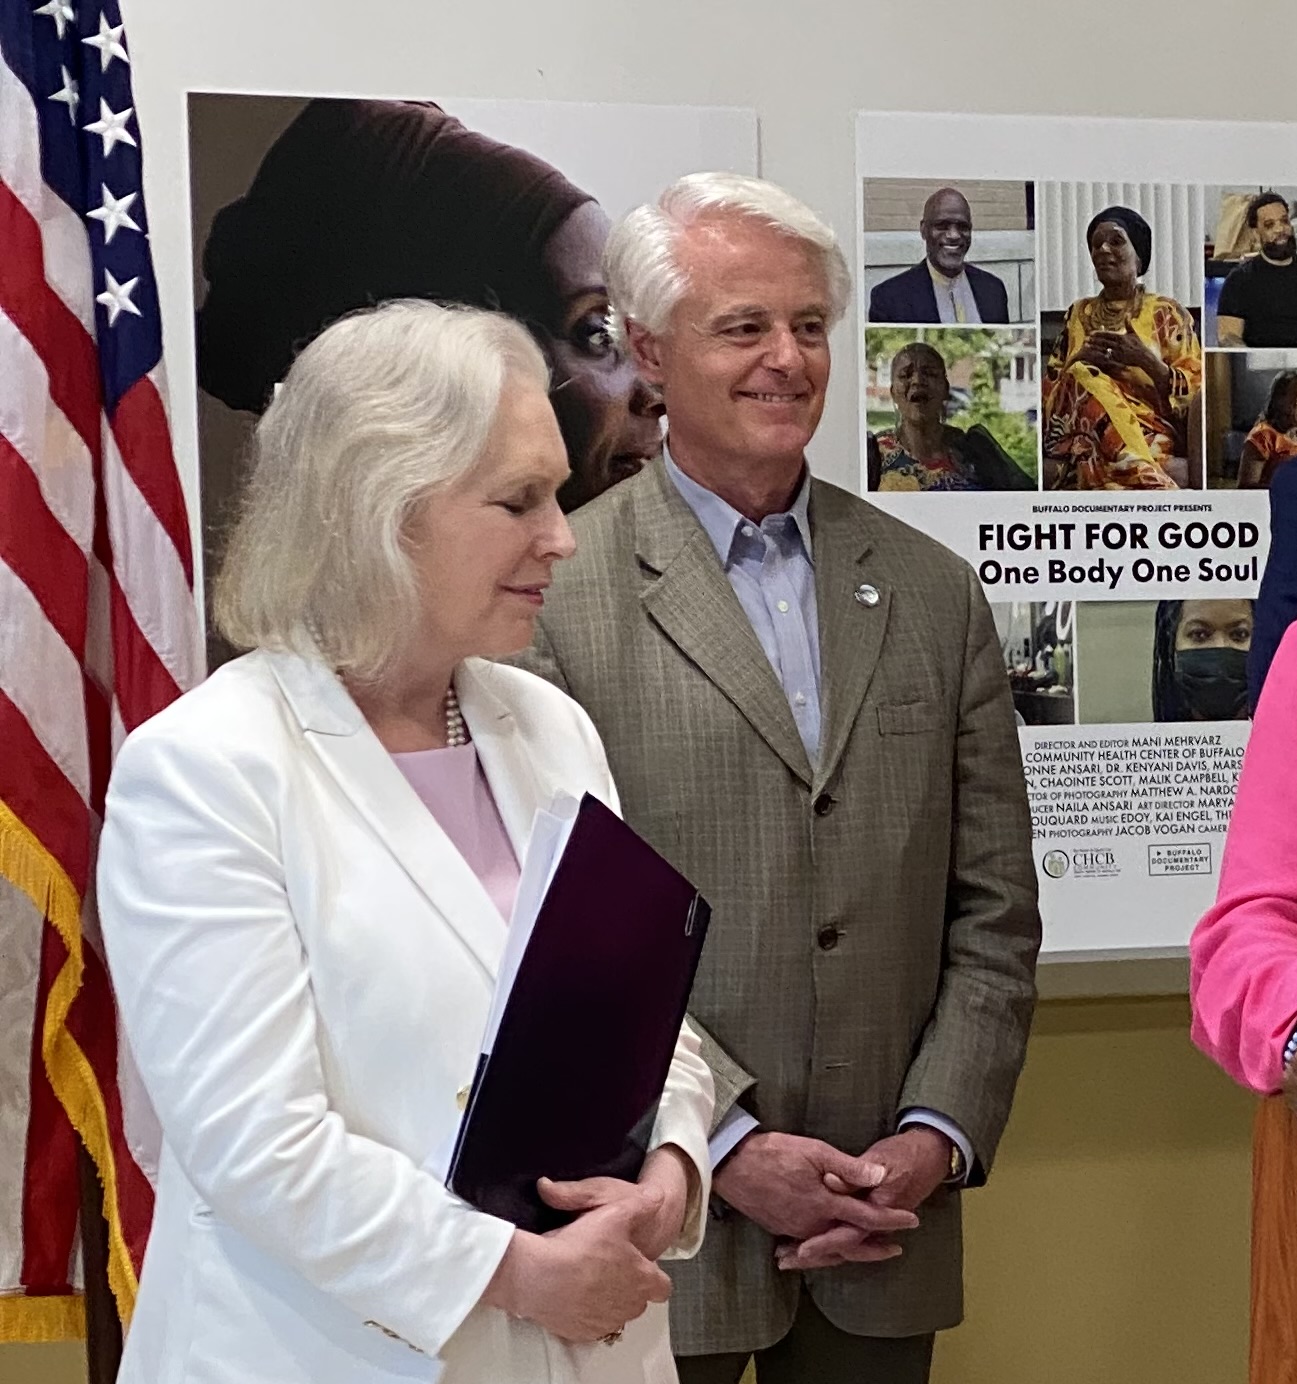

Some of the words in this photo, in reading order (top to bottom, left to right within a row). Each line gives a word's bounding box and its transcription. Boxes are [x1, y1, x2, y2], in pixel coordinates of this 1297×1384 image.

[1032, 505, 1070, 513] BUFFALO
[1071, 505, 1134, 513] DOCUMENTARY
[1137, 504, 1172, 512] PROJECT
[1174, 504, 1212, 512] PRESENTS
[979, 523, 1076, 550] FIGHT
[1086, 523, 1149, 550] FOR
[1158, 521, 1259, 549] GOOD
[979, 560, 1039, 584] One
[1050, 558, 1124, 589] Body
[1132, 558, 1190, 582] One
[1199, 556, 1258, 582] Soul
[1035, 741, 1076, 750] DIRECTOR
[1078, 740, 1098, 749] AND
[1100, 740, 1129, 749] EDITOR
[1132, 736, 1162, 747] MANI
[1165, 735, 1222, 746] MEHRVARZ
[1025, 751, 1095, 763] COMMUNITY
[1098, 750, 1137, 761] HEALTH
[1140, 749, 1179, 760] CENTER
[1182, 748, 1197, 759] OF
[1200, 747, 1245, 758] BUFFALO
[1060, 763, 1103, 774] ANSARI,
[1106, 763, 1123, 773] DR.
[1126, 761, 1174, 772] KENYANI
[1176, 760, 1210, 771] DAVIS,
[1213, 759, 1243, 770] MARS
[1040, 775, 1097, 788] CHAOINTE
[1100, 775, 1136, 787] SCOTT,
[1140, 774, 1171, 785] MALIK
[1174, 772, 1229, 784] CAMPBELL,
[1050, 791, 1062, 800] OF
[1064, 790, 1128, 800] PHOTOGRAPHY
[1131, 786, 1184, 797] MATTHEW
[1186, 786, 1197, 796] A.
[1056, 802, 1089, 813] NAILA
[1092, 801, 1133, 812] ANSARI
[1138, 801, 1153, 810] ART
[1155, 800, 1195, 809] DIRECTOR
[1198, 797, 1235, 808] MARYA
[1031, 814, 1088, 827] OUQUARD
[1091, 815, 1119, 824] MUSIC
[1121, 813, 1153, 824] EDOY,
[1156, 812, 1174, 822] KAI
[1176, 811, 1213, 822] ENGEL,
[1049, 828, 1113, 838] PHOTOGRAPHY
[1115, 825, 1151, 836] JACOB
[1153, 824, 1195, 835] VOGAN
[1198, 825, 1228, 834] CAMER
[1073, 852, 1115, 866] CHCB
